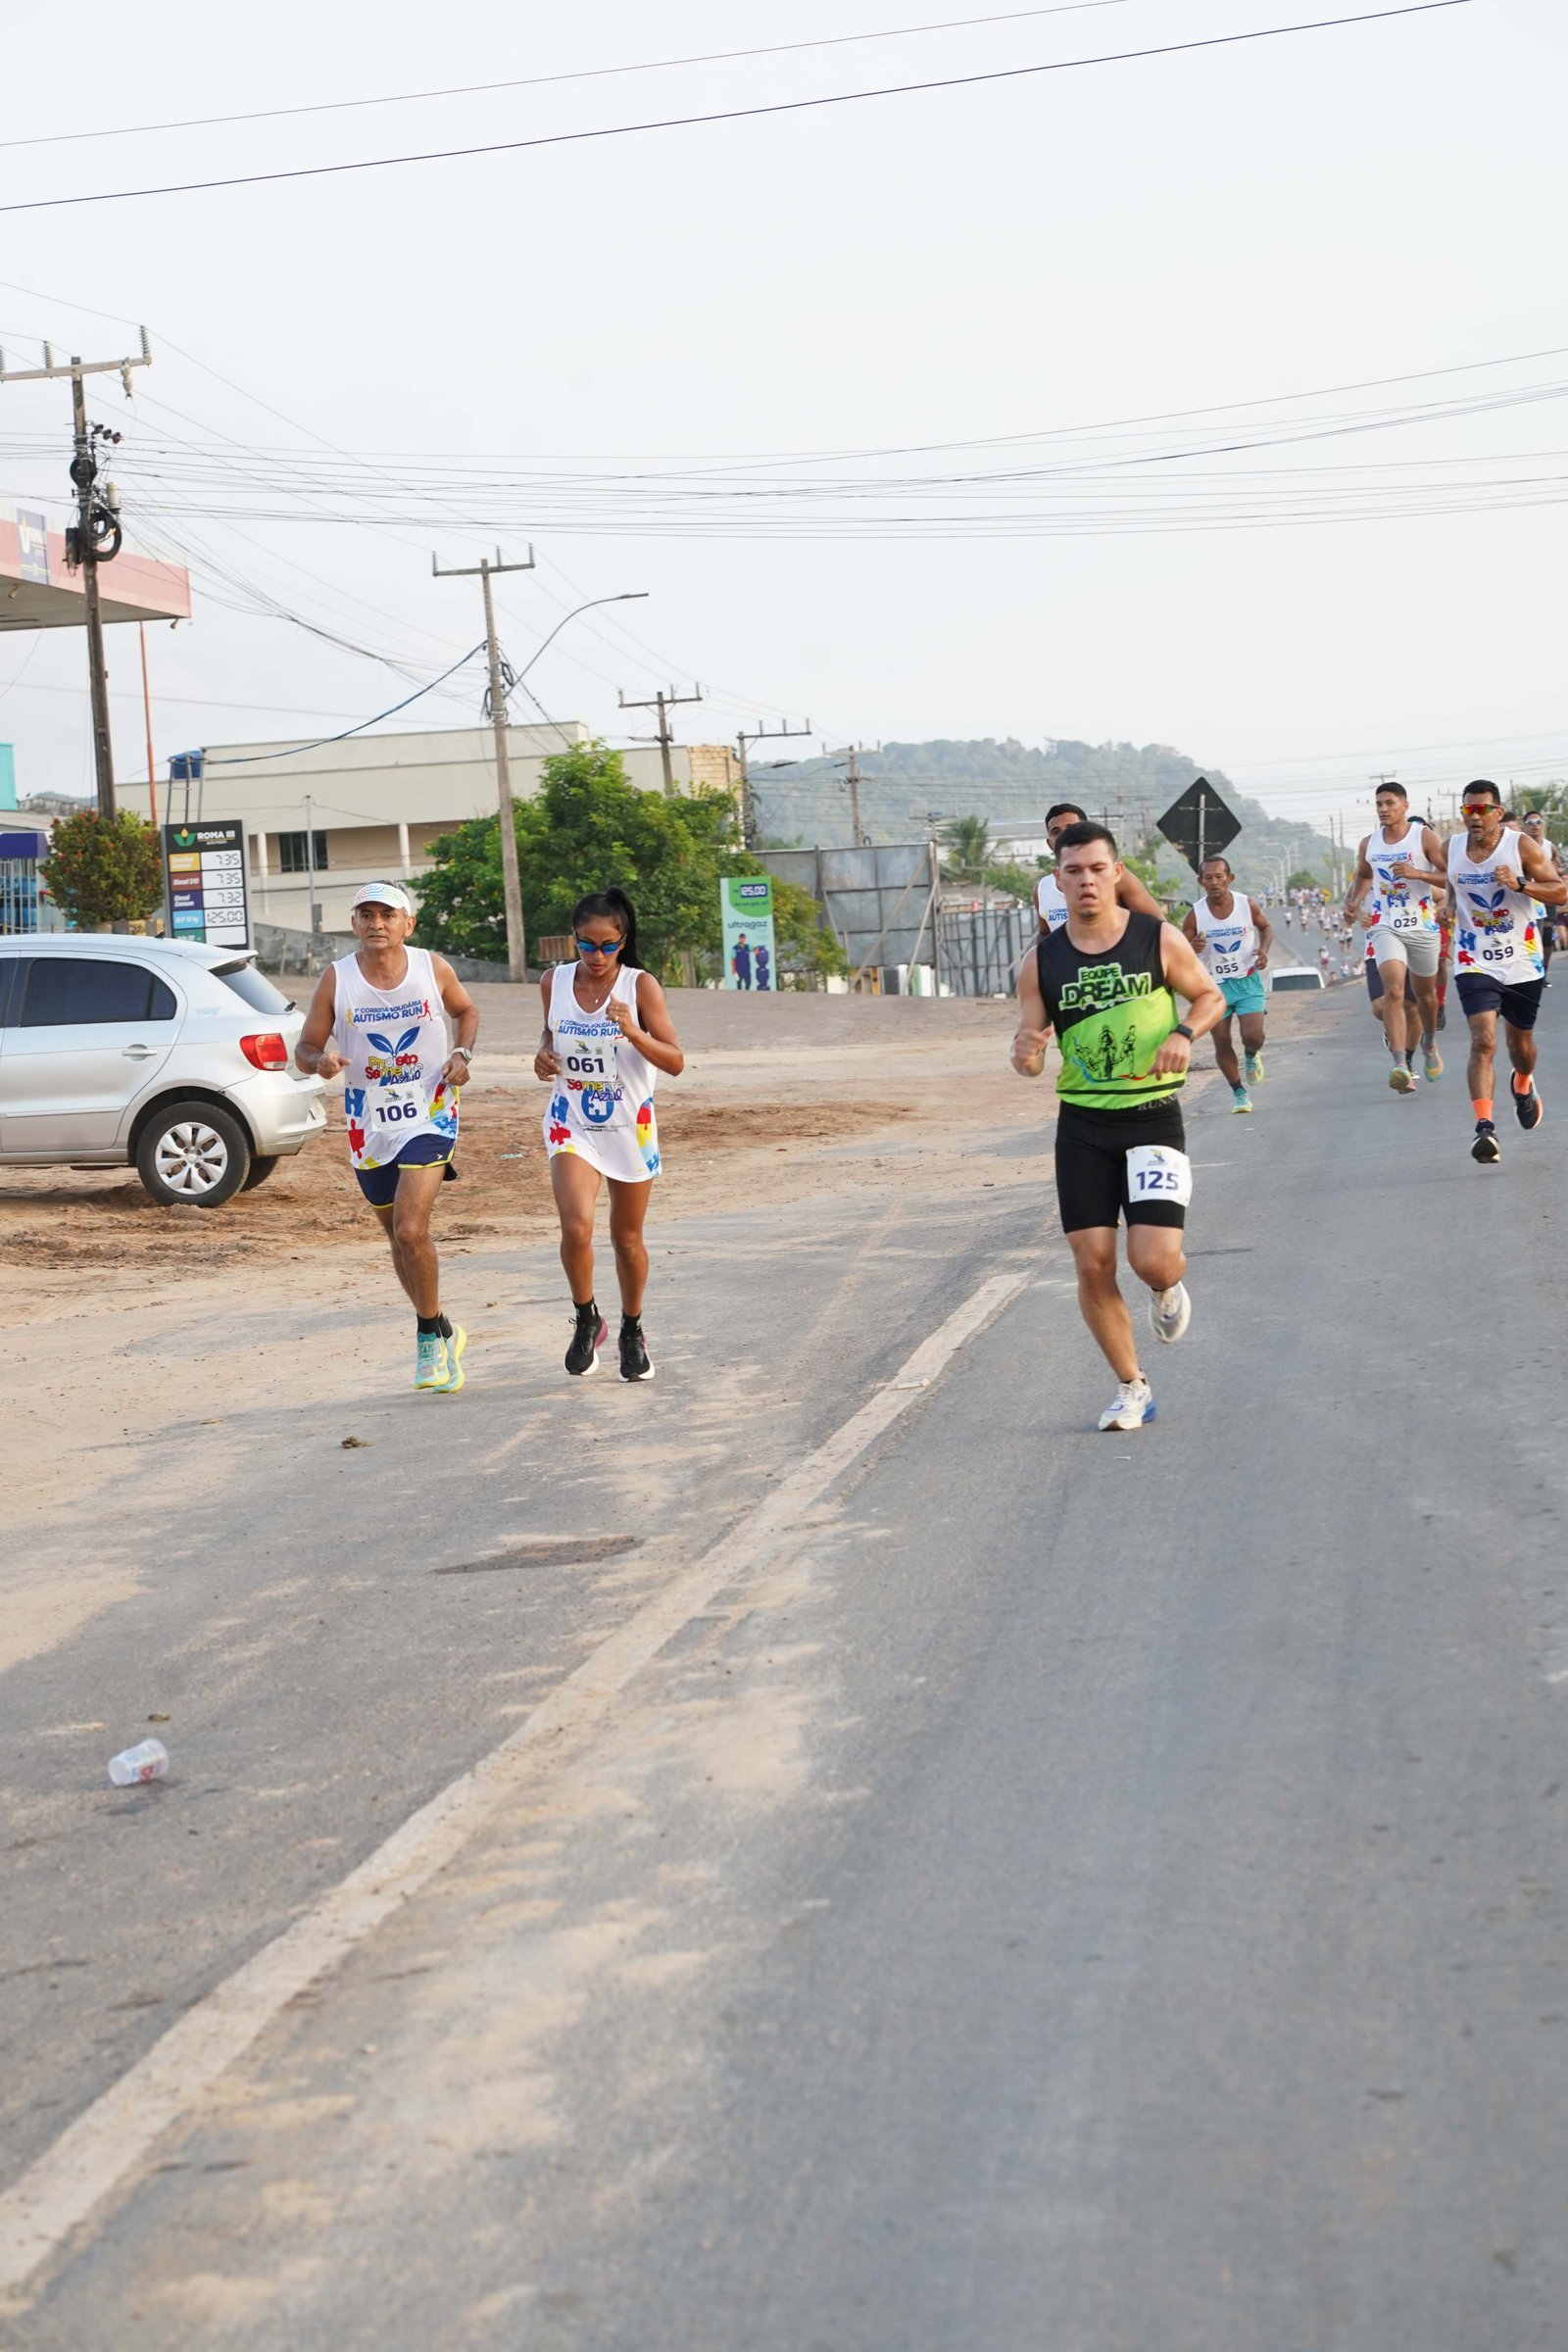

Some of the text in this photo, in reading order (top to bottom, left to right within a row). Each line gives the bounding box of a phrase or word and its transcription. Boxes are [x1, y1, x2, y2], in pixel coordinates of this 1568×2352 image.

[197, 831, 224, 840] ROMA
[1049, 912, 1068, 921] AUTIS
[1394, 916, 1417, 928] 029
[728, 920, 767, 930] ultragaz
[1483, 946, 1513, 960] 059
[1080, 967, 1119, 981] EQUIPE
[1215, 962, 1239, 974] 055
[1064, 974, 1149, 1004] DREAM
[390, 1000, 421, 1012] SOLIDÁRIA
[353, 1005, 423, 1023] AUTISMO RUN
[558, 1025, 621, 1037] AUTISMO RUN
[566, 1056, 605, 1073] 061
[591, 1089, 623, 1102] Azul
[375, 1102, 417, 1123] 106
[1136, 1170, 1179, 1191] 125
